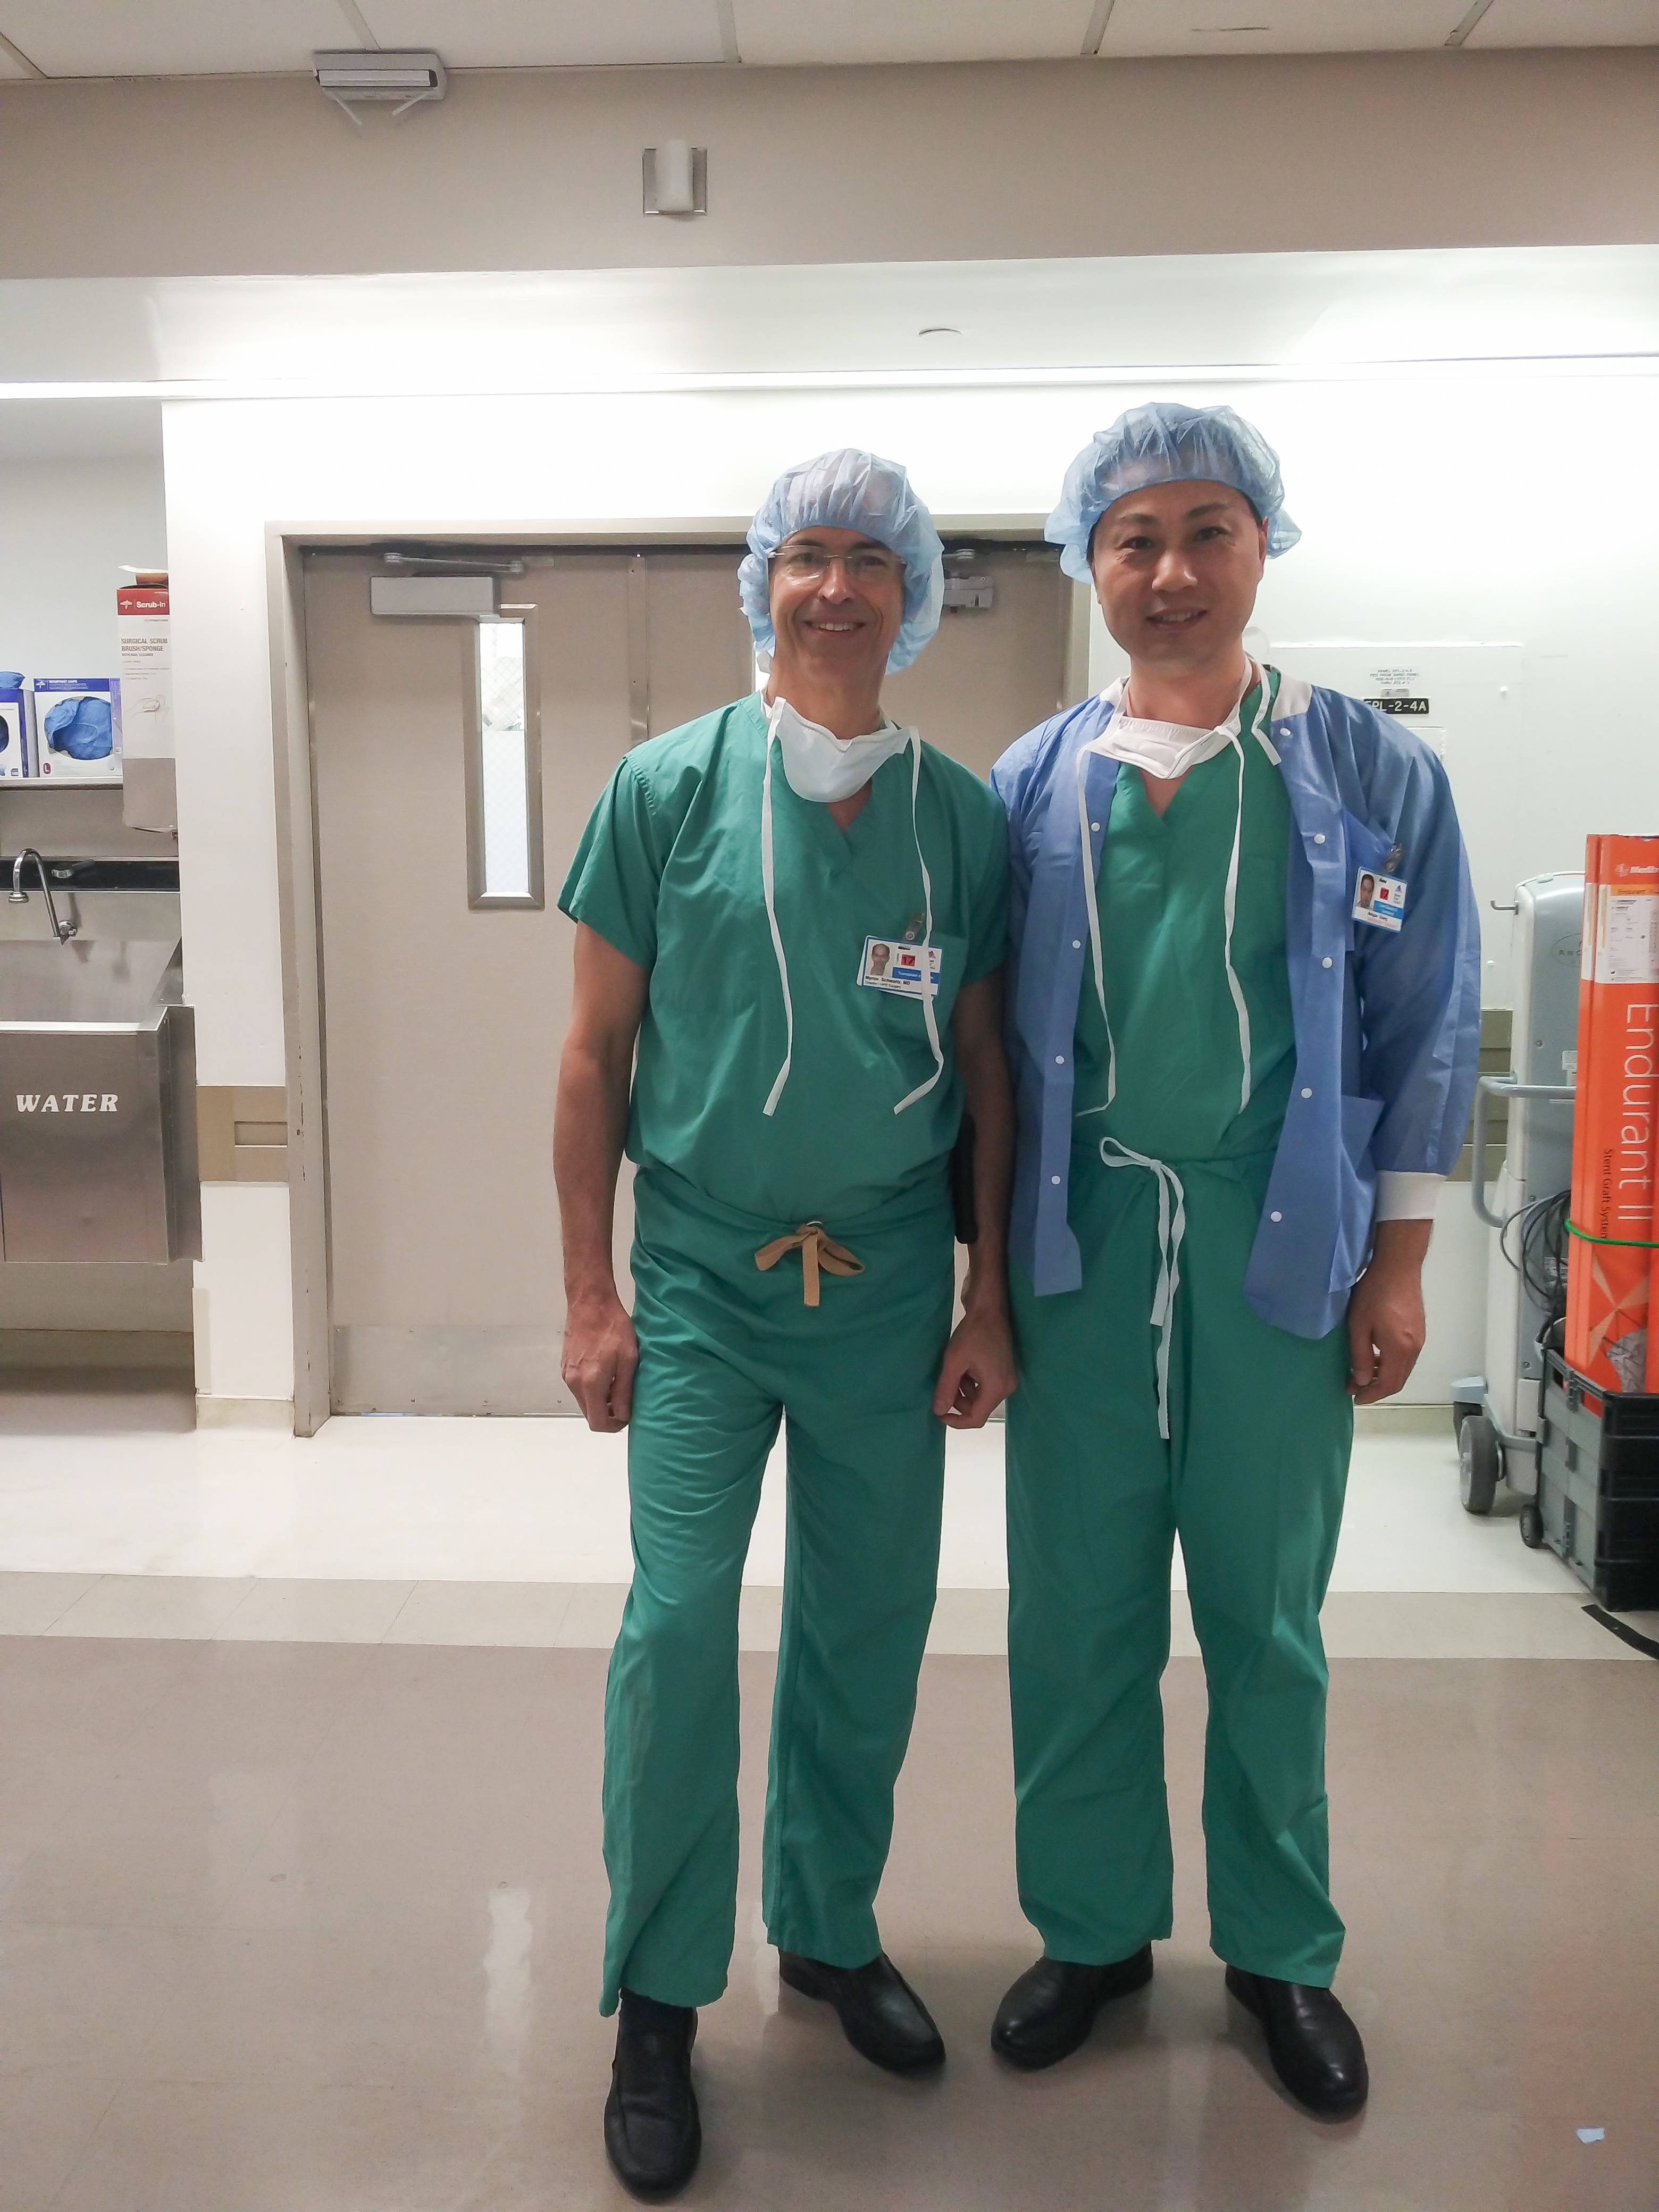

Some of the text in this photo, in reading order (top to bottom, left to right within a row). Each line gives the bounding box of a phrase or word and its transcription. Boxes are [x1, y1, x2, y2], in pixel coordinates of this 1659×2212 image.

[903, 956, 915, 965] 17
[16, 1093, 119, 1112] WATER
[1619, 1003, 1659, 1189] Endurant
[1603, 1149, 1613, 1174] Stent
[1601, 1178, 1612, 1203] Graft
